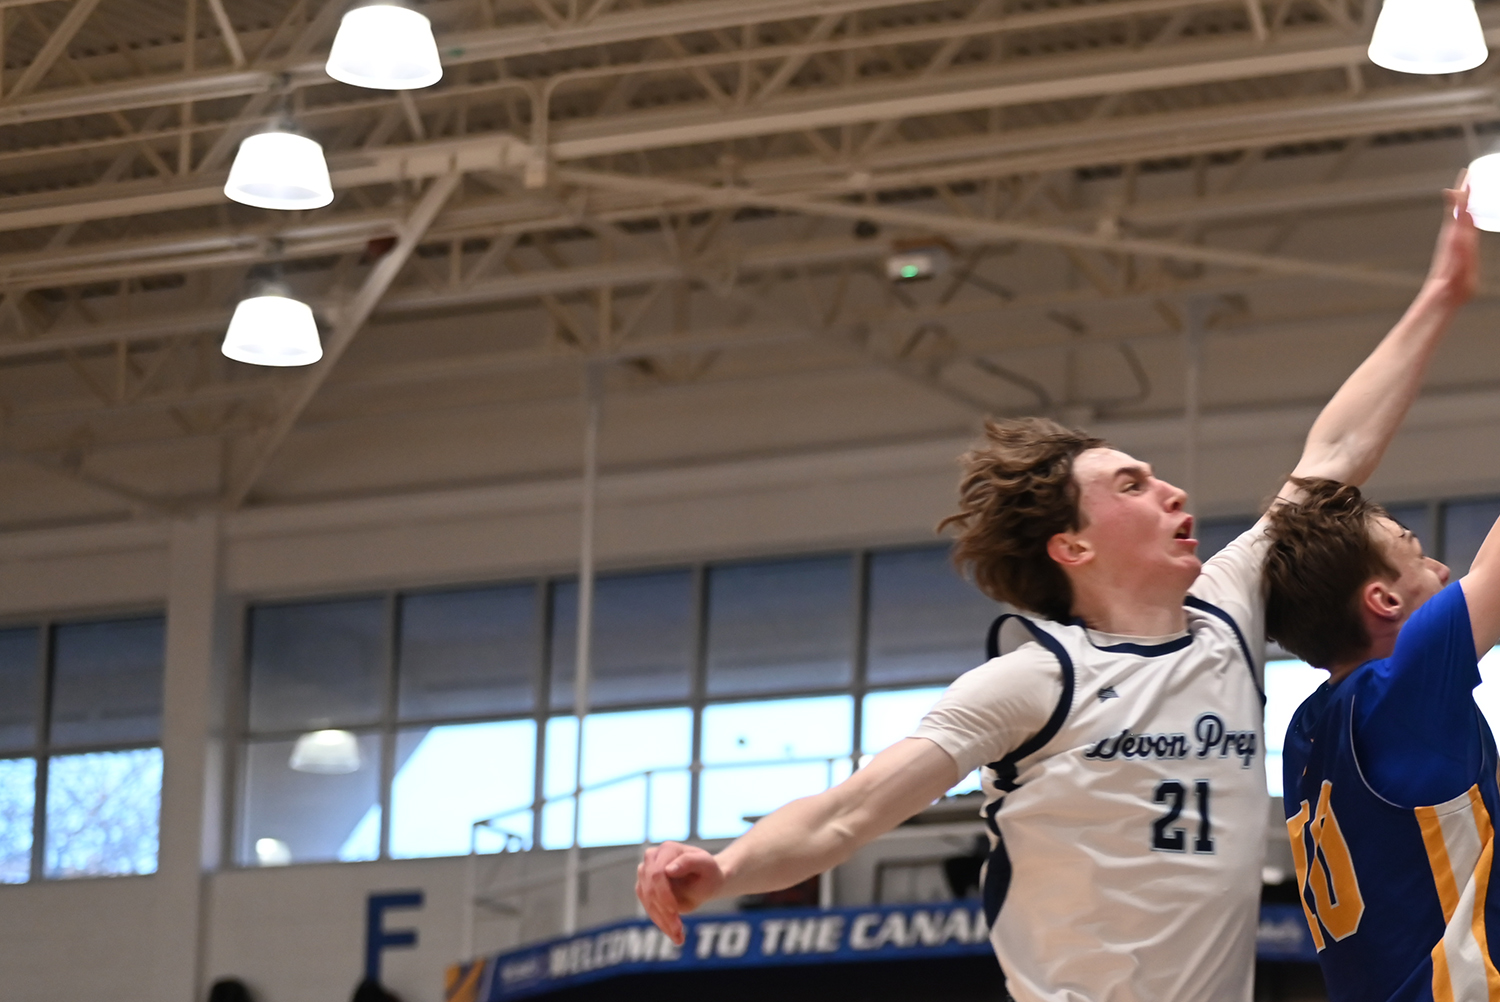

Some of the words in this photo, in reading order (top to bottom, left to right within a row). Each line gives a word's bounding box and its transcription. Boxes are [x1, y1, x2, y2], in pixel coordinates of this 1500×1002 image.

[1152, 779, 1214, 855] 21
[364, 889, 424, 981] F
[550, 919, 682, 978] WELCOME
[696, 922, 750, 957] TO
[761, 915, 844, 954] THE
